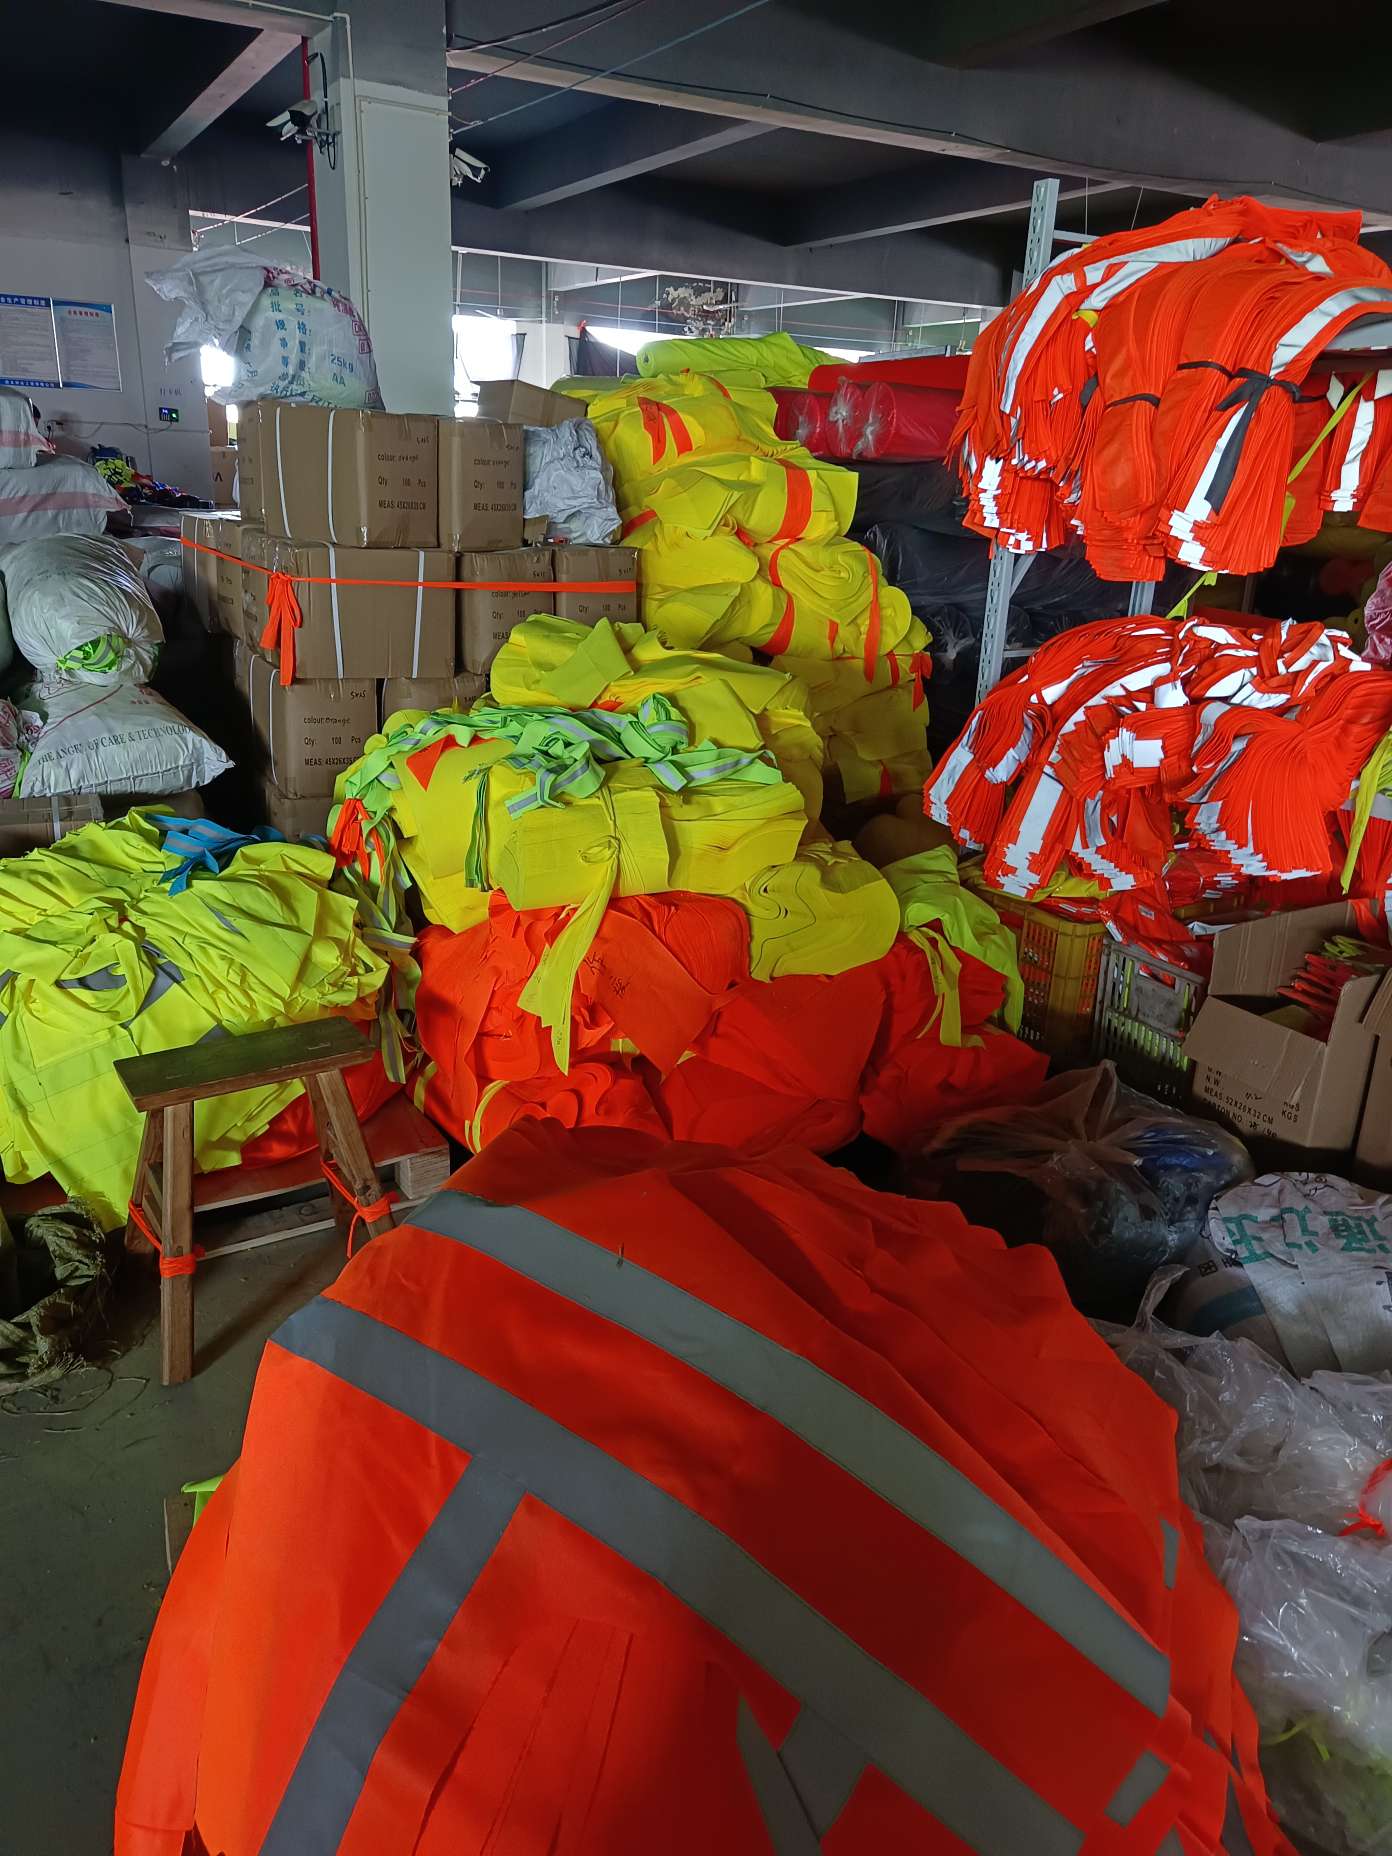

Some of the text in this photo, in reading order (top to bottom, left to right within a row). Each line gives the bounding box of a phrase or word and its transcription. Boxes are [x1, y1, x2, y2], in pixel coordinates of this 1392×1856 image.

[330, 353, 354, 372] 25kg
[331, 372, 347, 387] AA
[36, 750, 55, 765] THE
[100, 731, 128, 748] CARE
[127, 731, 136, 743] &
[331, 736, 342, 745] 100
[1281, 1109, 1299, 1123] KGS
